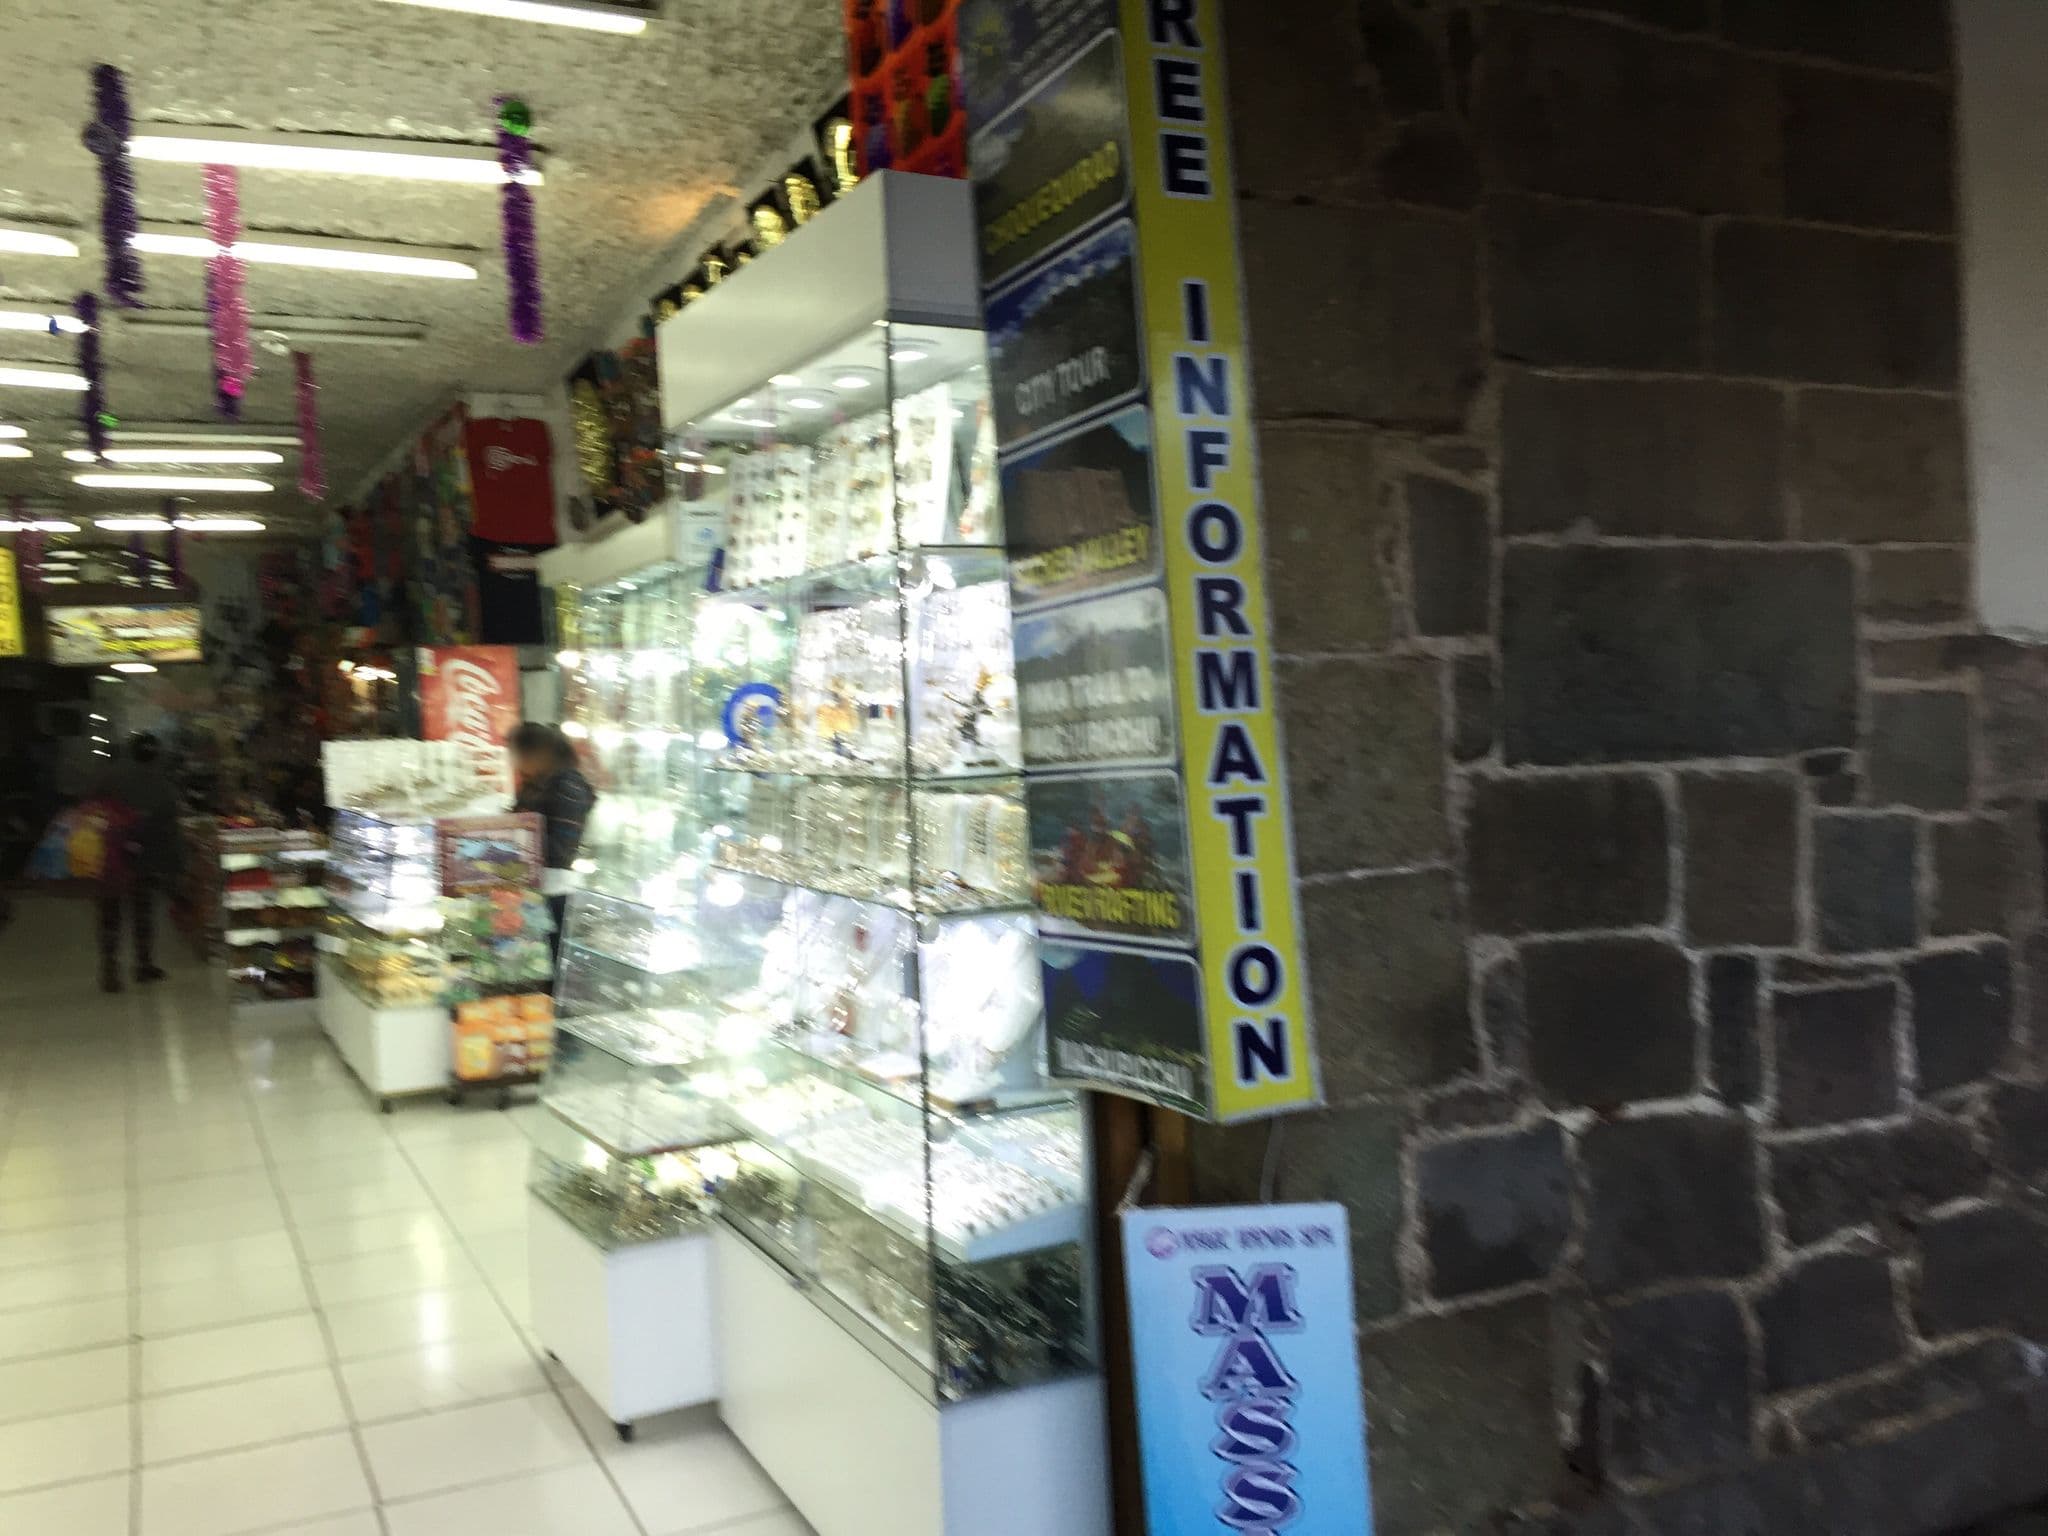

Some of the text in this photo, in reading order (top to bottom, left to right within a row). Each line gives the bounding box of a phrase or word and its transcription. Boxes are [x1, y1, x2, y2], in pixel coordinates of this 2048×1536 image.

[1015, 346, 1111, 416] CITY TOUR
[1176, 281, 1289, 1084] INFORMATION
[1099, 886, 1181, 929] RAFTING
[1188, 1262, 1306, 1536] MASS
